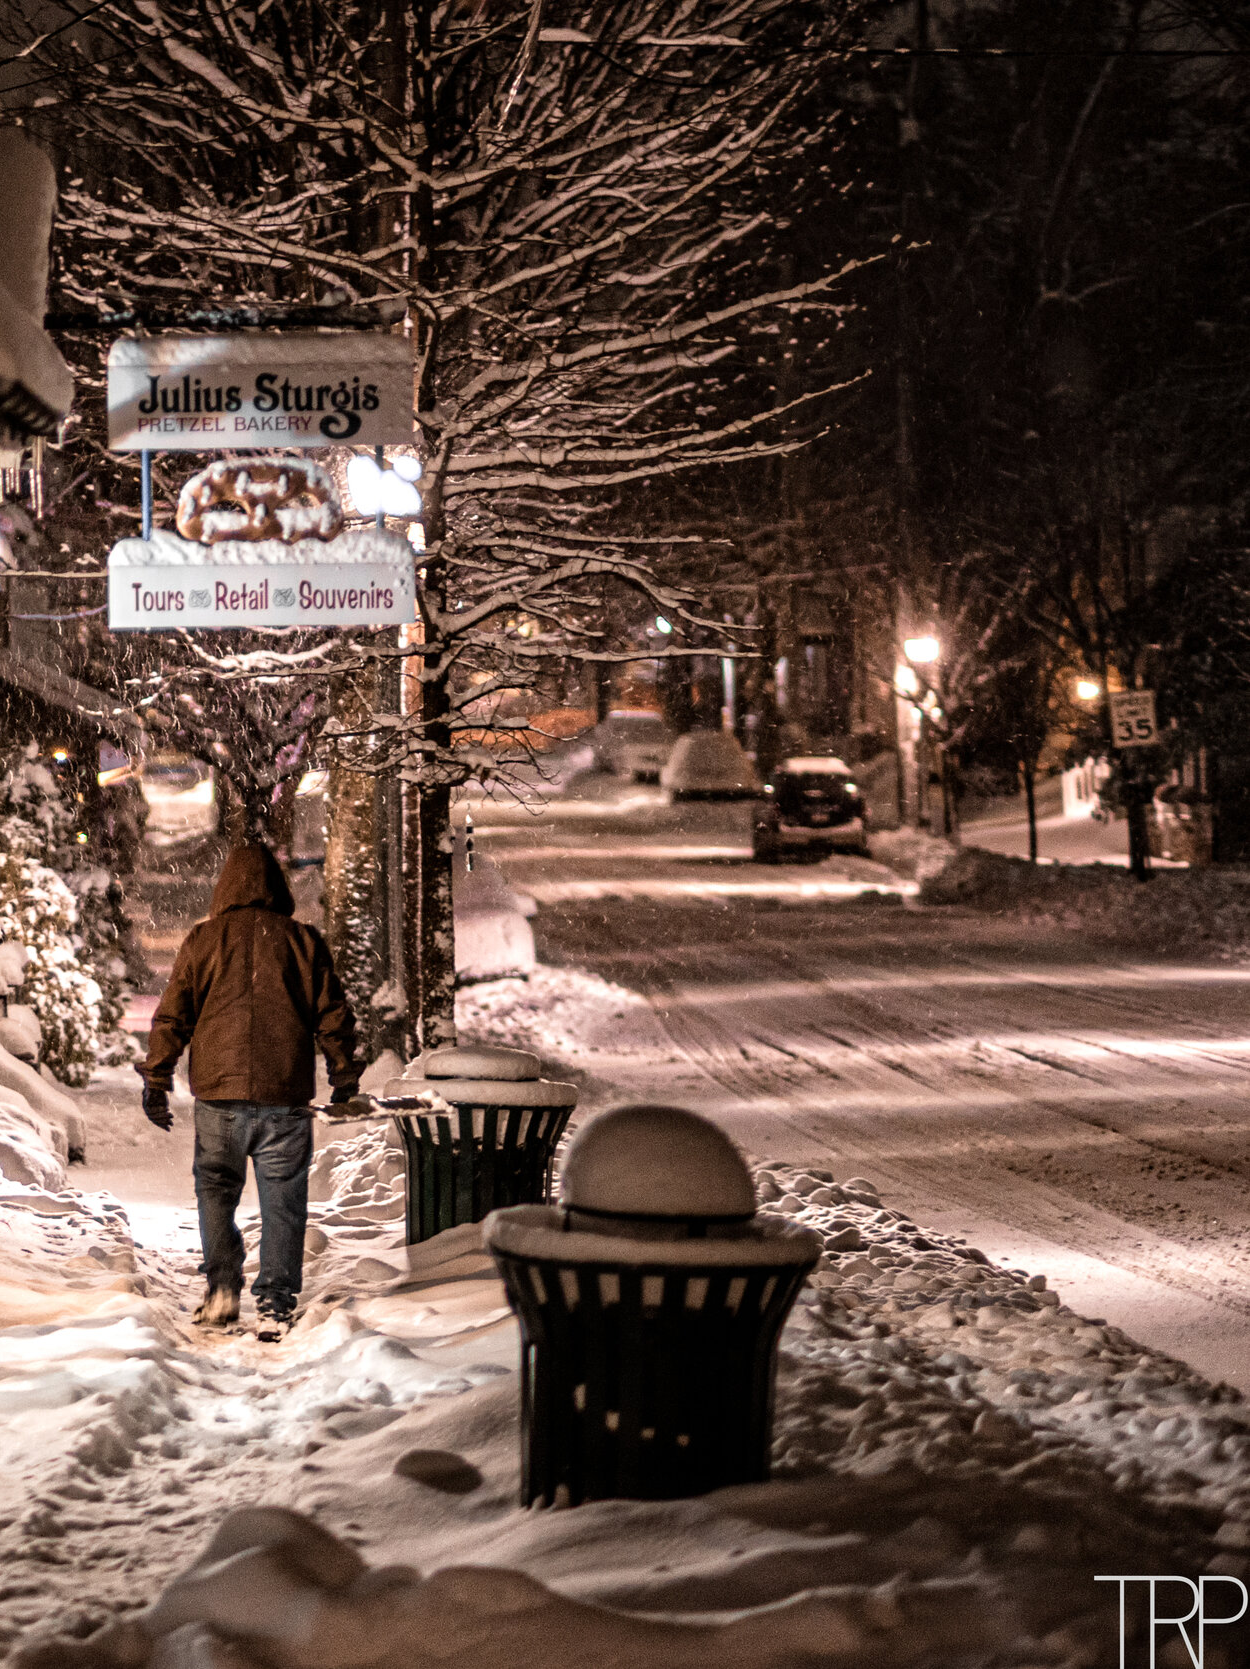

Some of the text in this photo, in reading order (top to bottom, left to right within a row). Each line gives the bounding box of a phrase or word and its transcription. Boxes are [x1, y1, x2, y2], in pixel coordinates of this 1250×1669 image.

[138, 372, 380, 439] Julius Sturgis
[137, 415, 313, 432] PRETZEL BAKERY
[131, 578, 395, 612] Tours Retail Souvenirs
[1118, 718, 1153, 742] 35
